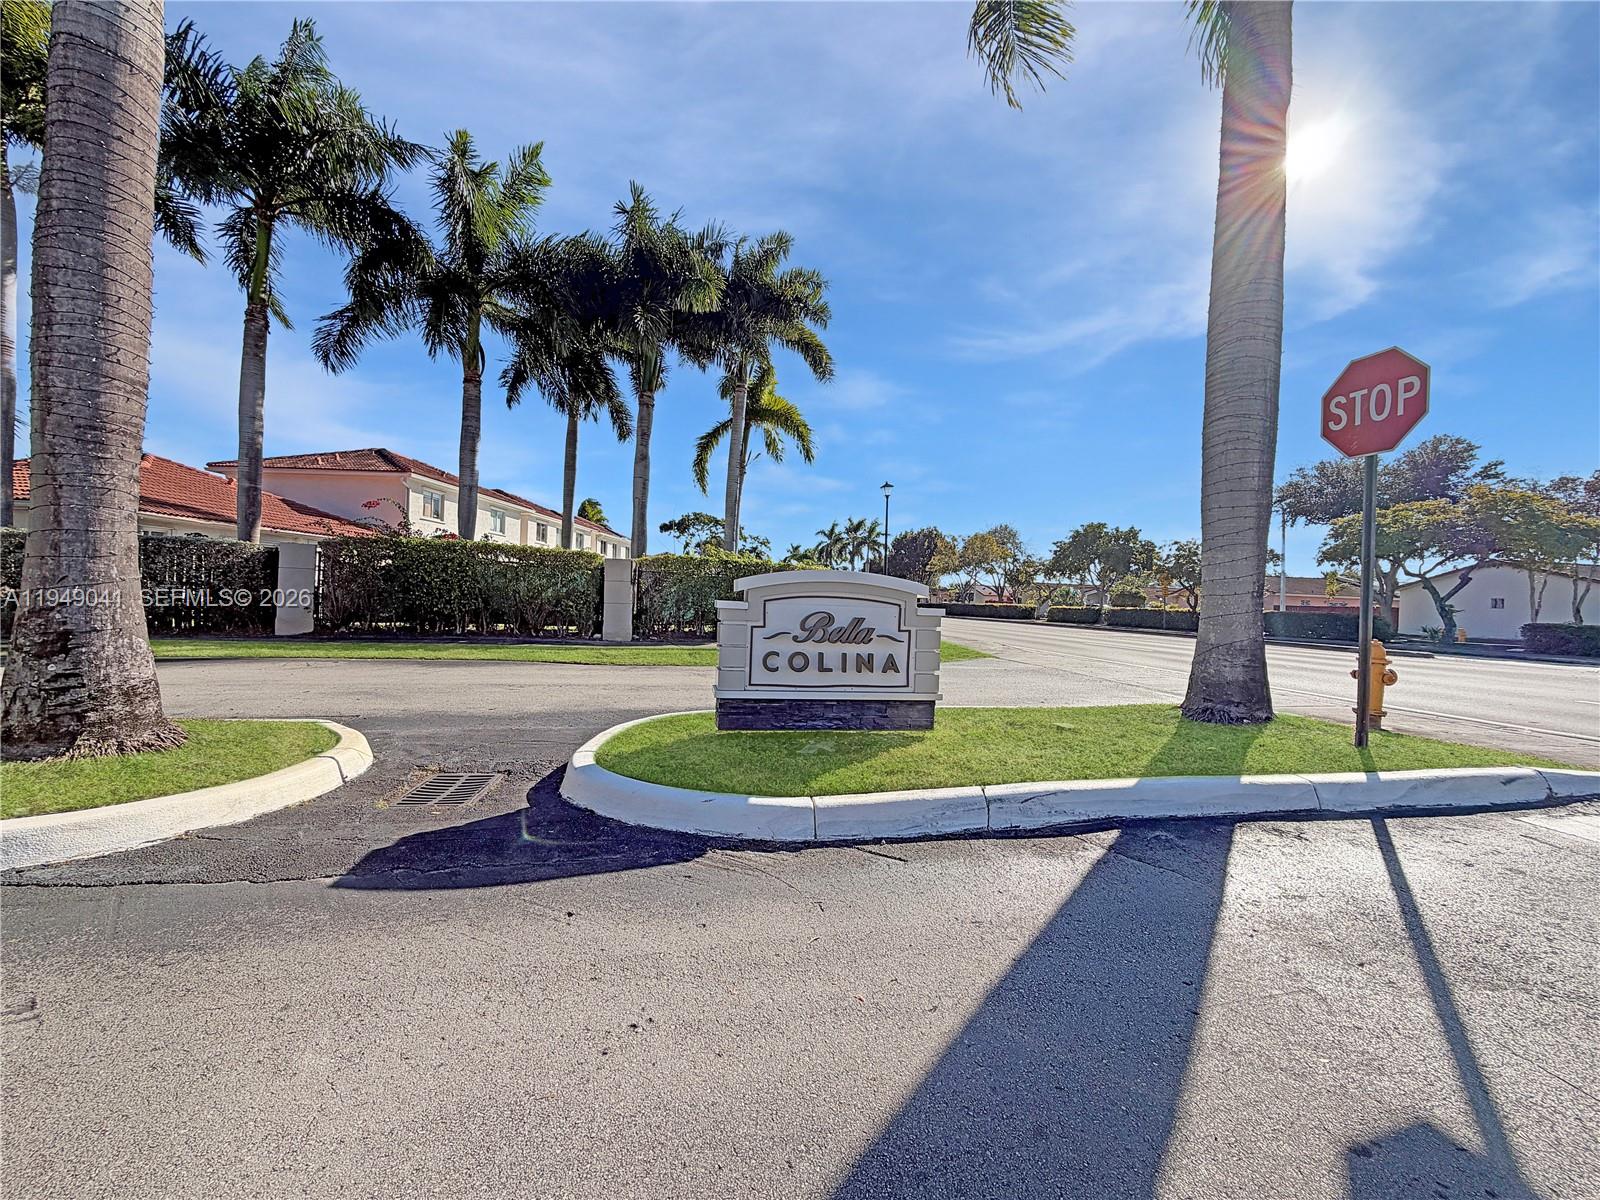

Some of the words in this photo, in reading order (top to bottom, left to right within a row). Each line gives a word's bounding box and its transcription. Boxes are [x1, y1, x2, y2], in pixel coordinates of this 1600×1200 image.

[1328, 375, 1421, 431] STOP
[792, 611, 876, 644] Bella
[762, 650, 900, 673] COLINA
